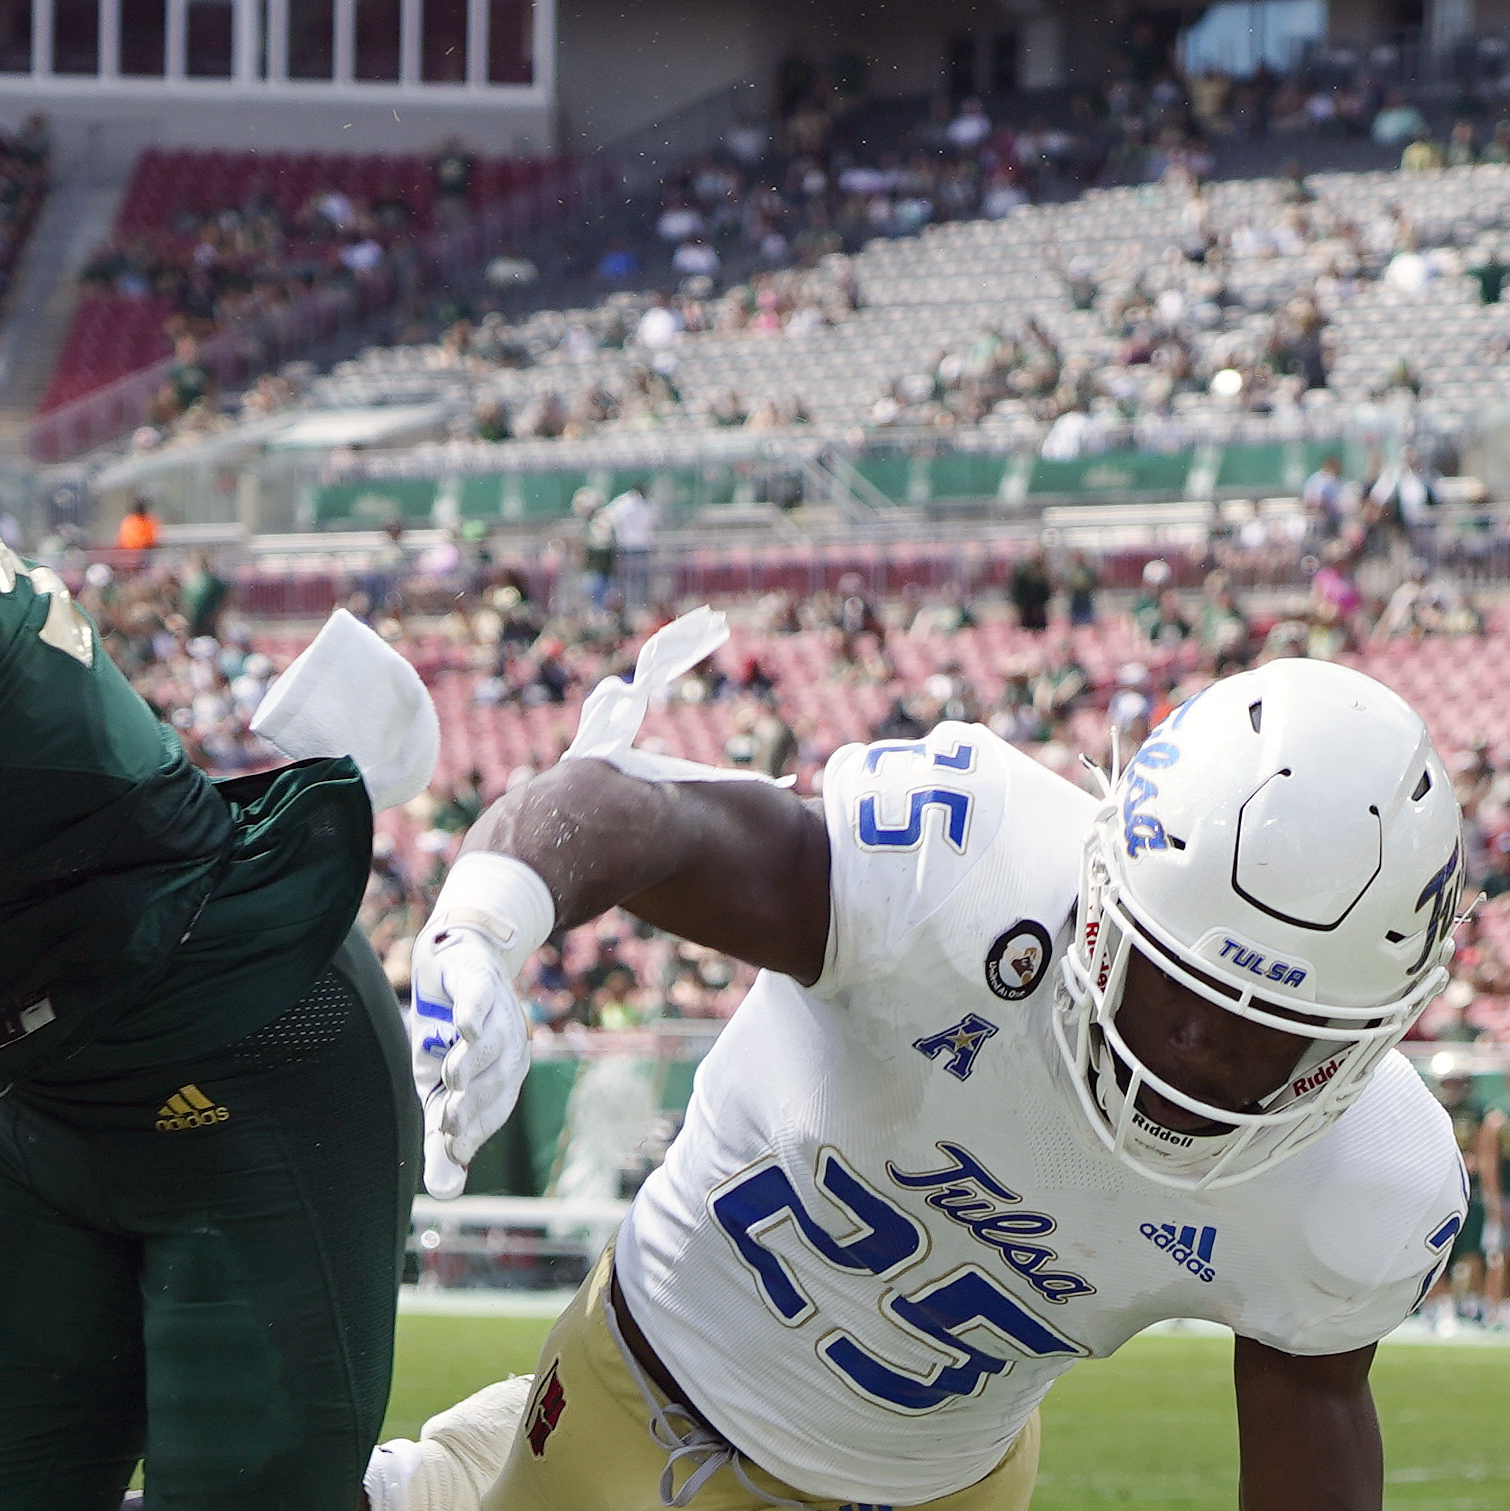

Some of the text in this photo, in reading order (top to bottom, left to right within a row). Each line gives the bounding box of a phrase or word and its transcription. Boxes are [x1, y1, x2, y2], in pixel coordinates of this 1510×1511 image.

[1219, 937, 1309, 990] TULSA
[154, 1106, 230, 1132] adidas
[1131, 1111, 1195, 1149] Riddell
[885, 1140, 1098, 1305] Tulsa
[706, 1144, 1095, 1417] 25
[1139, 1222, 1217, 1284] adidas
